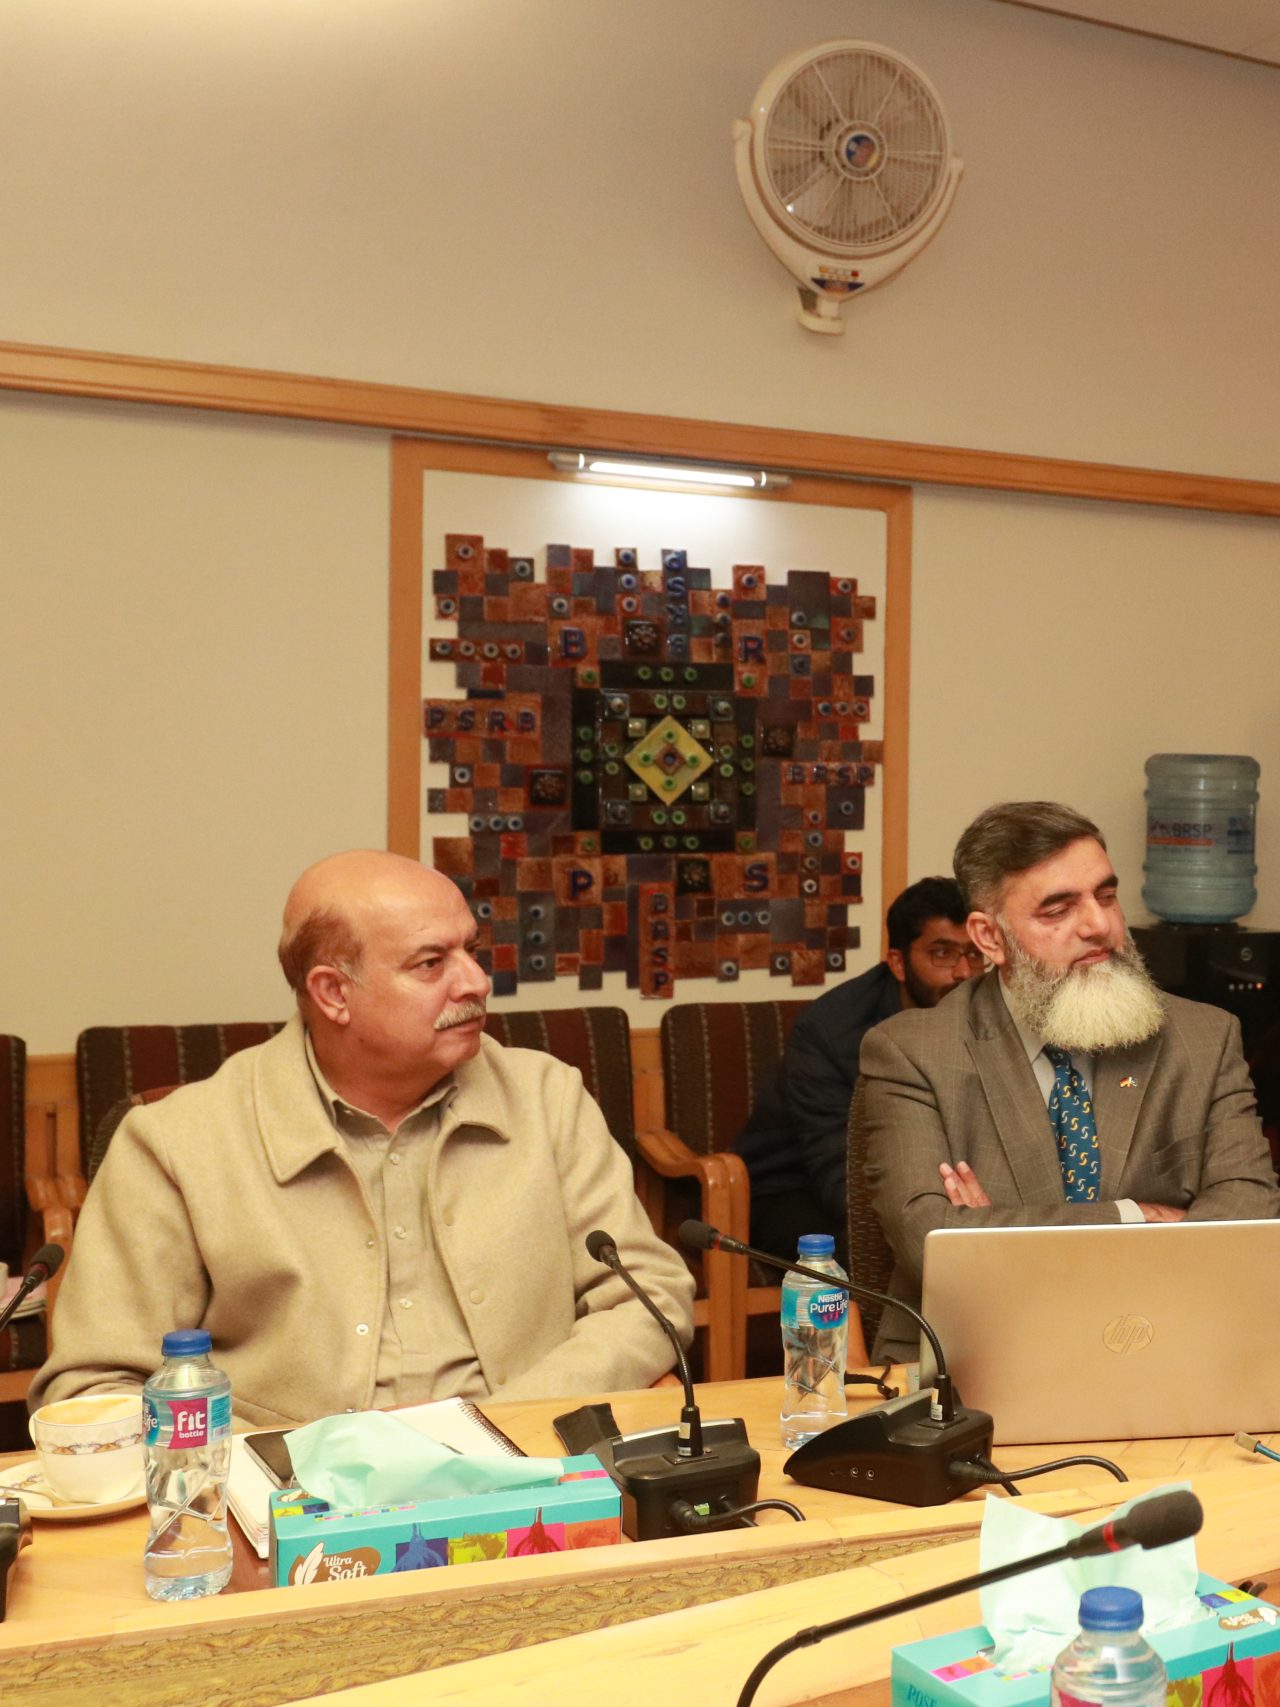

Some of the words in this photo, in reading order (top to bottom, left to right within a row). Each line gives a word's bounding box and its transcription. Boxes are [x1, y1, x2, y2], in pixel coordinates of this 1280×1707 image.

[810, 1302, 836, 1313] Pure
[1106, 1314, 1149, 1355] hp
[177, 1410, 206, 1431] fit
[179, 1430, 204, 1439] bottle
[323, 1555, 353, 1567] Ultra
[327, 1560, 369, 1582] Soft
